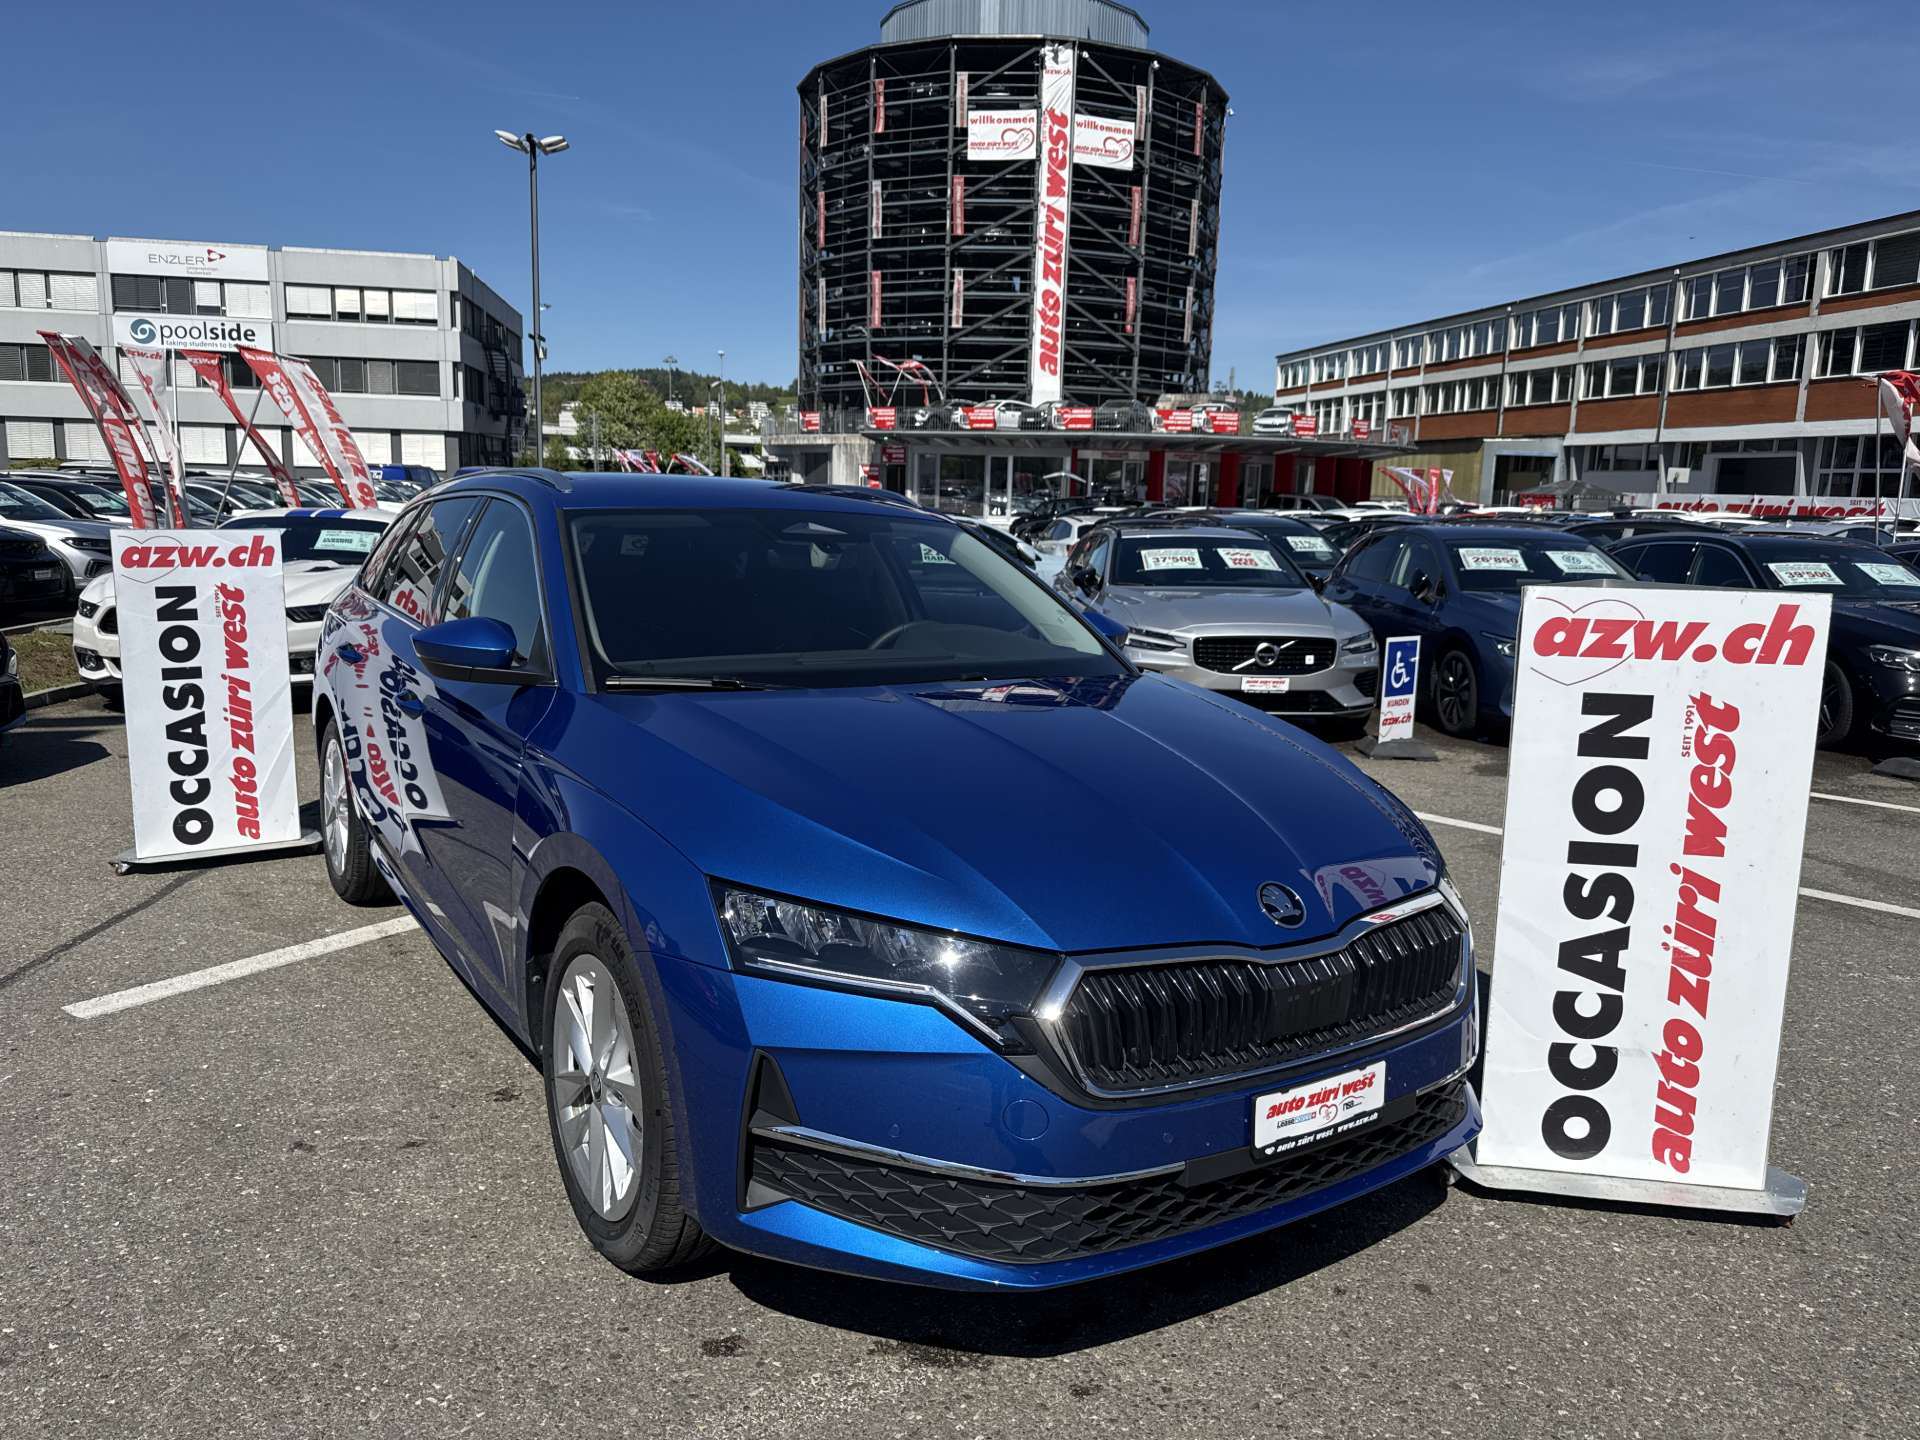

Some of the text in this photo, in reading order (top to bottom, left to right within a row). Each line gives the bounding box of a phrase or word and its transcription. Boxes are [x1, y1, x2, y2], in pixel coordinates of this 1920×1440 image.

[969, 115, 1035, 125] willkommen
[1075, 120, 1133, 136] willkommen
[148, 253, 205, 266] ENZLER
[1038, 108, 1068, 377] auto züri west
[160, 321, 256, 345] poolside
[189, 341, 218, 349] students
[121, 536, 275, 568] azw.ch
[1533, 604, 1815, 666] azw.ch
[155, 585, 214, 845] OCCASION
[214, 582, 261, 841] auto züri west
[1681, 705, 1696, 758] SEIT 1991
[1541, 692, 1655, 1161] OCCASION
[1651, 690, 1741, 1175] auto züri west
[1266, 1095, 1306, 1119] auto
[1305, 1082, 1342, 1108] züri
[1342, 1072, 1376, 1097] west
[1277, 1141, 1296, 1153] auto
